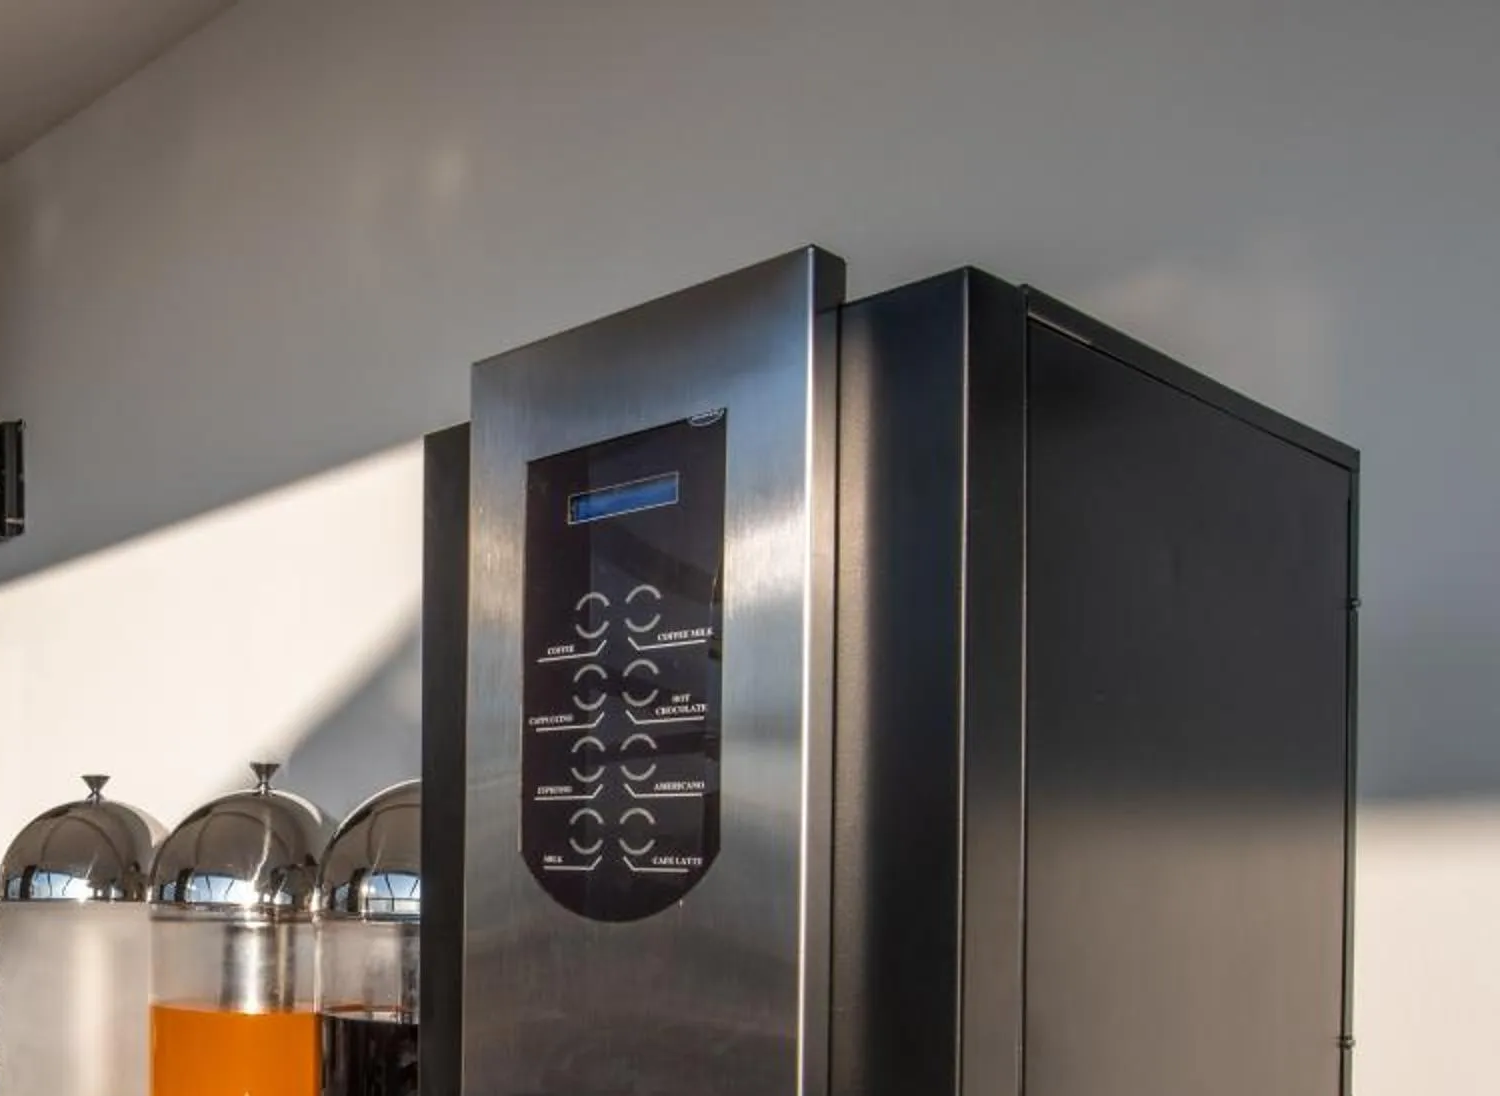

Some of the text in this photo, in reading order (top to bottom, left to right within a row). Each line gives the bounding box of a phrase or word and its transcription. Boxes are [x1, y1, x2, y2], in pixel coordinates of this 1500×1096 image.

[657, 627, 714, 641] COFFEE MILK
[547, 645, 575, 655] COFFEE
[671, 694, 691, 703] HOT
[655, 704, 708, 716] CHOCOLATE
[653, 781, 705, 792] AMERICANO
[675, 857, 703, 865] LATTE
